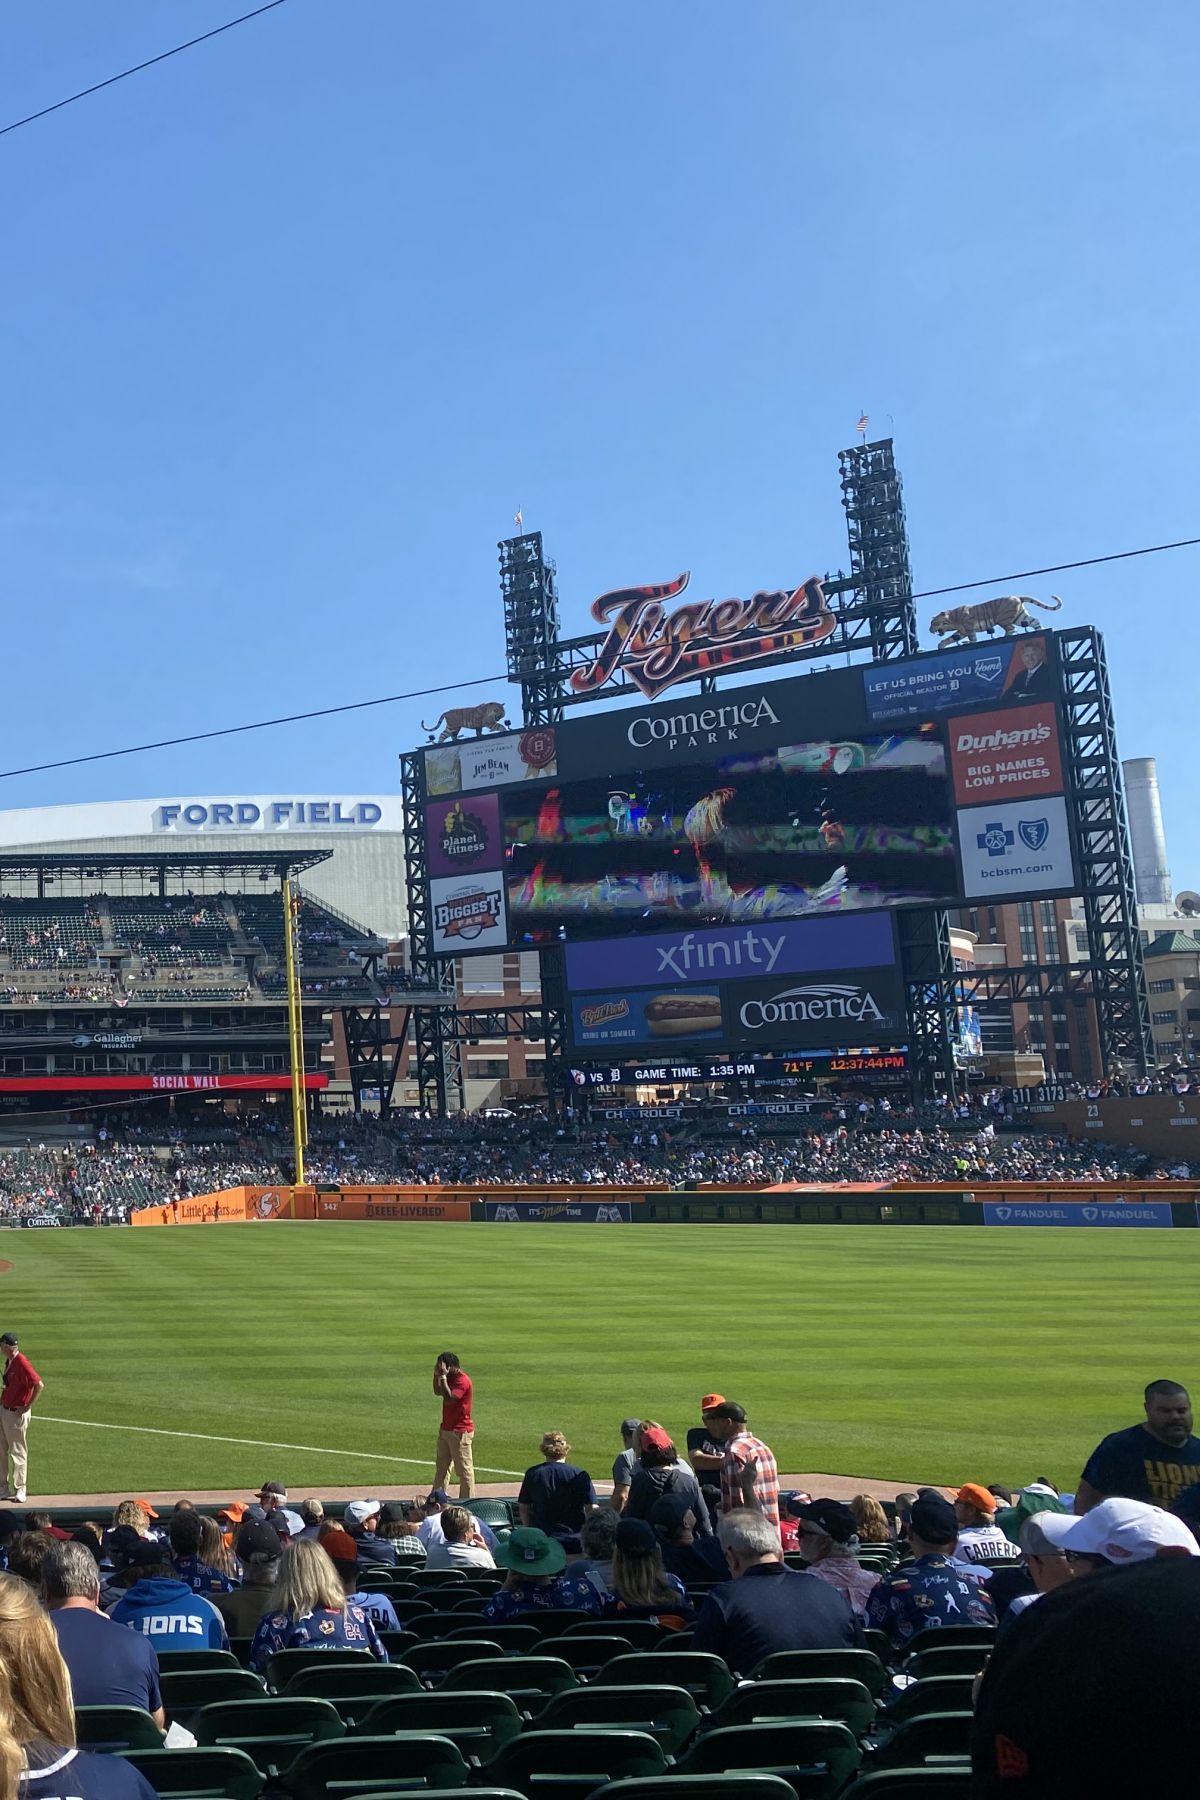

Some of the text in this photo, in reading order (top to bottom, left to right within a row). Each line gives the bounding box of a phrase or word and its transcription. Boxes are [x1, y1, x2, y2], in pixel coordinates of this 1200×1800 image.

[570, 571, 837, 701] Tigers
[869, 682, 889, 693] LET
[891, 679, 906, 689] US
[909, 672, 945, 685] BRING
[947, 666, 972, 678] YOU
[884, 690, 914, 701] OFFICIAL
[916, 684, 947, 695] REALTOR
[669, 728, 739, 750] PARK
[957, 722, 1052, 752] Dunham's
[473, 764, 487, 779] JIM
[488, 759, 510, 772] BEAM
[967, 757, 1046, 777] BIG NAMES
[965, 768, 1051, 789] LOW PRICES
[160, 801, 383, 826] FORD FIELD
[443, 834, 477, 849] planet
[448, 841, 485, 855] fitness
[981, 864, 1054, 879] bcbsm.com
[438, 893, 500, 927] BIGGEST
[656, 930, 787, 979] xfinity
[93, 1033, 143, 1045] Gallagher
[590, 1073, 604, 1082] VS
[635, 1069, 667, 1079] GAME
[671, 1067, 702, 1078] TIME:
[710, 1066, 734, 1076] 1:35
[737, 1064, 755, 1075] PM
[152, 1076, 221, 1089] SOCIAL WALL
[1012, 1085, 1064, 1103] 511 3173
[605, 1108, 683, 1120] CHEVROLET
[727, 1104, 813, 1116] CHEVROLET
[1087, 1105, 1099, 1117] 23
[1178, 1100, 1185, 1113] 5
[1014, 1209, 1069, 1219] FANDUEL
[1101, 1210, 1158, 1220] FANDUEL
[963, 1541, 1018, 1561] CABRERA
[343, 1622, 366, 1641] 24
